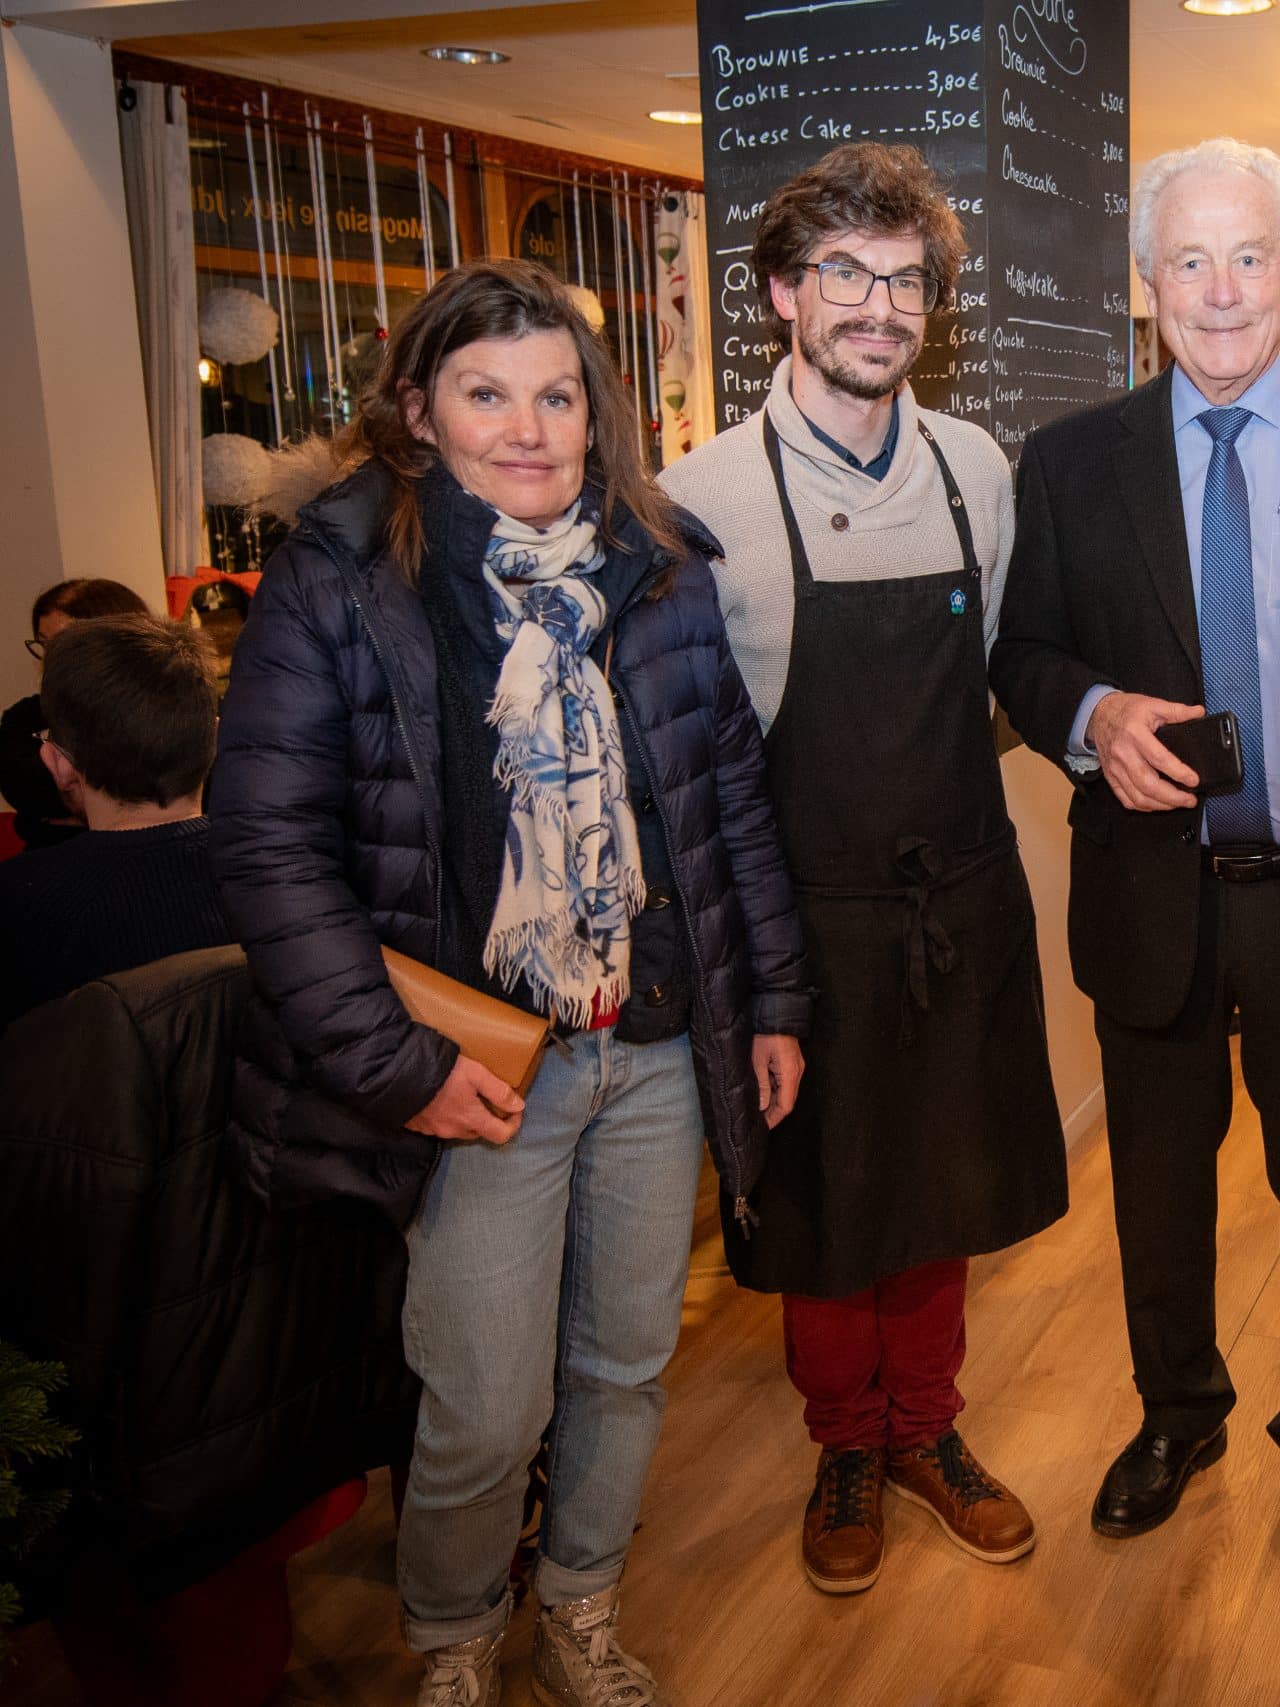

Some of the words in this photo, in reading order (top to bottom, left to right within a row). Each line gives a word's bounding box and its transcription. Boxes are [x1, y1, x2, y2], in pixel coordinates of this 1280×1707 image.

[925, 24, 982, 51] 4,50€
[927, 70, 980, 98] 3,80€
[718, 127, 790, 151] Cheese
[800, 115, 853, 140] Cake
[925, 109, 982, 135] 5,50€
[724, 336, 783, 364] Croqu
[949, 324, 988, 350] 6,50€
